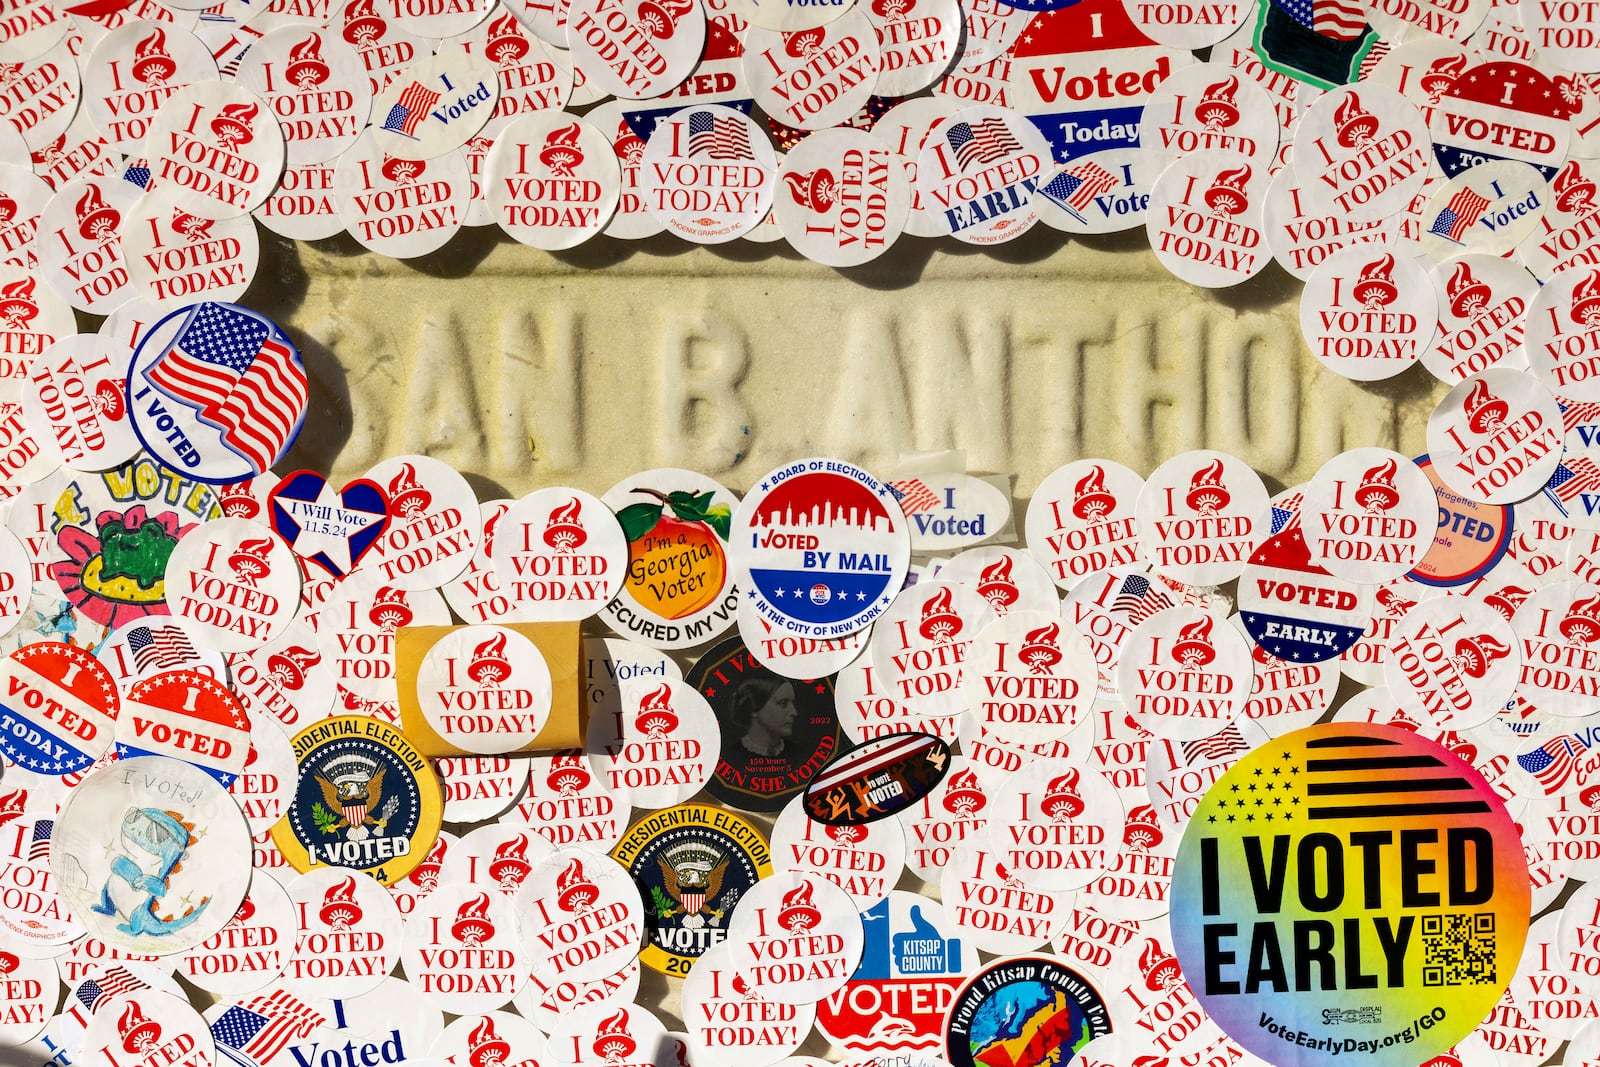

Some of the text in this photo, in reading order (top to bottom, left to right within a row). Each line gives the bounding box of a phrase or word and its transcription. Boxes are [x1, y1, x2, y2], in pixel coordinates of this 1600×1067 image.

[1138, 5, 1237, 25] TODAY!
[574, 11, 651, 96] TODAY!
[771, 37, 859, 101] VOTED
[786, 55, 877, 124] TODAY!
[1029, 57, 1170, 102] Voted
[431, 82, 491, 125] Voted
[1446, 113, 1556, 154] VOTED
[170, 131, 259, 184] VOTED
[1320, 130, 1412, 190] VOTED
[160, 157, 251, 209] TODAY!
[505, 180, 600, 201] VOTED
[653, 164, 764, 187] VOTED
[931, 154, 1040, 208] VOTED
[1333, 150, 1427, 215] TODAY!
[354, 181, 451, 215] VOTED
[653, 189, 759, 213] TODAY!
[839, 150, 864, 248] VOTED
[864, 150, 890, 249] TODAY!
[945, 176, 1040, 234] EARLY
[1480, 191, 1540, 232] Voted
[358, 205, 458, 242] TODAY!
[504, 206, 599, 228] TODAY!
[1167, 206, 1260, 249] VOTED
[144, 238, 240, 274] VOTED
[1160, 231, 1254, 274] TODAY!
[150, 264, 245, 300] TODAY!
[1319, 311, 1417, 334] VOTED
[1436, 297, 1525, 362] VOTED
[1318, 338, 1416, 360] TODAY!
[32, 367, 84, 463] TODAY!
[57, 358, 105, 451] VOTED
[135, 386, 201, 468] I VOTED
[1456, 410, 1543, 477] VOTED
[771, 461, 878, 490] BOARD OF ELECTIONS
[1472, 428, 1561, 499] TODAY!
[291, 502, 366, 525] I Will Vote
[304, 520, 348, 538] 11.5.24
[913, 514, 985, 536] Voted
[1153, 517, 1251, 541] VOTED
[1320, 514, 1416, 538] VOTED
[372, 509, 461, 557] VOTED
[644, 533, 691, 552] I'm a
[753, 534, 758, 548] I
[379, 530, 473, 581] TODAY!
[510, 556, 607, 576] VOTED
[629, 543, 712, 586] Georgia
[803, 551, 892, 572] BY MAIL
[1319, 539, 1416, 564] TODAY!
[188, 571, 278, 616] VOTED
[511, 582, 608, 601] TODAY!
[647, 572, 706, 602] Voter
[1256, 579, 1358, 611] VOTED
[180, 596, 271, 641] TODAY!
[684, 616, 713, 640] MY
[756, 600, 882, 635] IN THE CITY OF NEW YORK
[1265, 621, 1338, 646] EARLY
[1137, 669, 1233, 694] VOTED
[1390, 636, 1454, 727] TODAY!
[1415, 623, 1473, 711] VOTED
[437, 690, 533, 711] VOTED
[983, 677, 1079, 699] VOTED
[8, 676, 97, 742] VOTED
[444, 715, 535, 733] TODAY!
[982, 703, 1077, 724] TODAY!
[1136, 695, 1232, 720] TODAY!
[2, 719, 68, 761] TODAY
[134, 718, 232, 761] VOTED
[366, 723, 424, 771] ELECTION
[606, 739, 701, 765] VOTED
[607, 765, 704, 789] TODAY!
[749, 777, 787, 792] SHE
[790, 735, 835, 784] VOTED
[875, 772, 891, 786] VOTE
[869, 780, 904, 805] VOTED
[517, 797, 613, 823] VOTED
[325, 837, 410, 861] VOTED
[617, 809, 771, 865] PRESIDENTIAL ELECTION
[1008, 825, 1104, 845] VOTED
[790, 844, 885, 872] VOTED
[1009, 850, 1105, 871] TODAY!
[1201, 827, 1494, 916] I VOTED
[960, 881, 1054, 915] VOTED
[537, 903, 628, 951] VOTED
[955, 906, 1052, 940] TODAY!
[184, 951, 280, 976] TODAY!
[420, 949, 514, 969] VOTED
[548, 923, 640, 974] TODAY!
[748, 935, 844, 961] VOTED
[902, 956, 942, 971] COUNTY
[903, 940, 940, 955] KITSAP
[1203, 916, 1415, 995] EARLY
[290, 956, 387, 979] TODAY!
[420, 975, 515, 994] TODAY!
[751, 959, 847, 986] TODAY!
[701, 1003, 796, 1022] VOTED
[826, 983, 957, 1016] VOTED
[951, 965, 1086, 1035] Proud Kitsap County
[701, 1027, 797, 1046] TODAY!
[1258, 1007, 1446, 1055] VoteEarlyDay.org/GO
[287, 1030, 406, 1067] Voted
